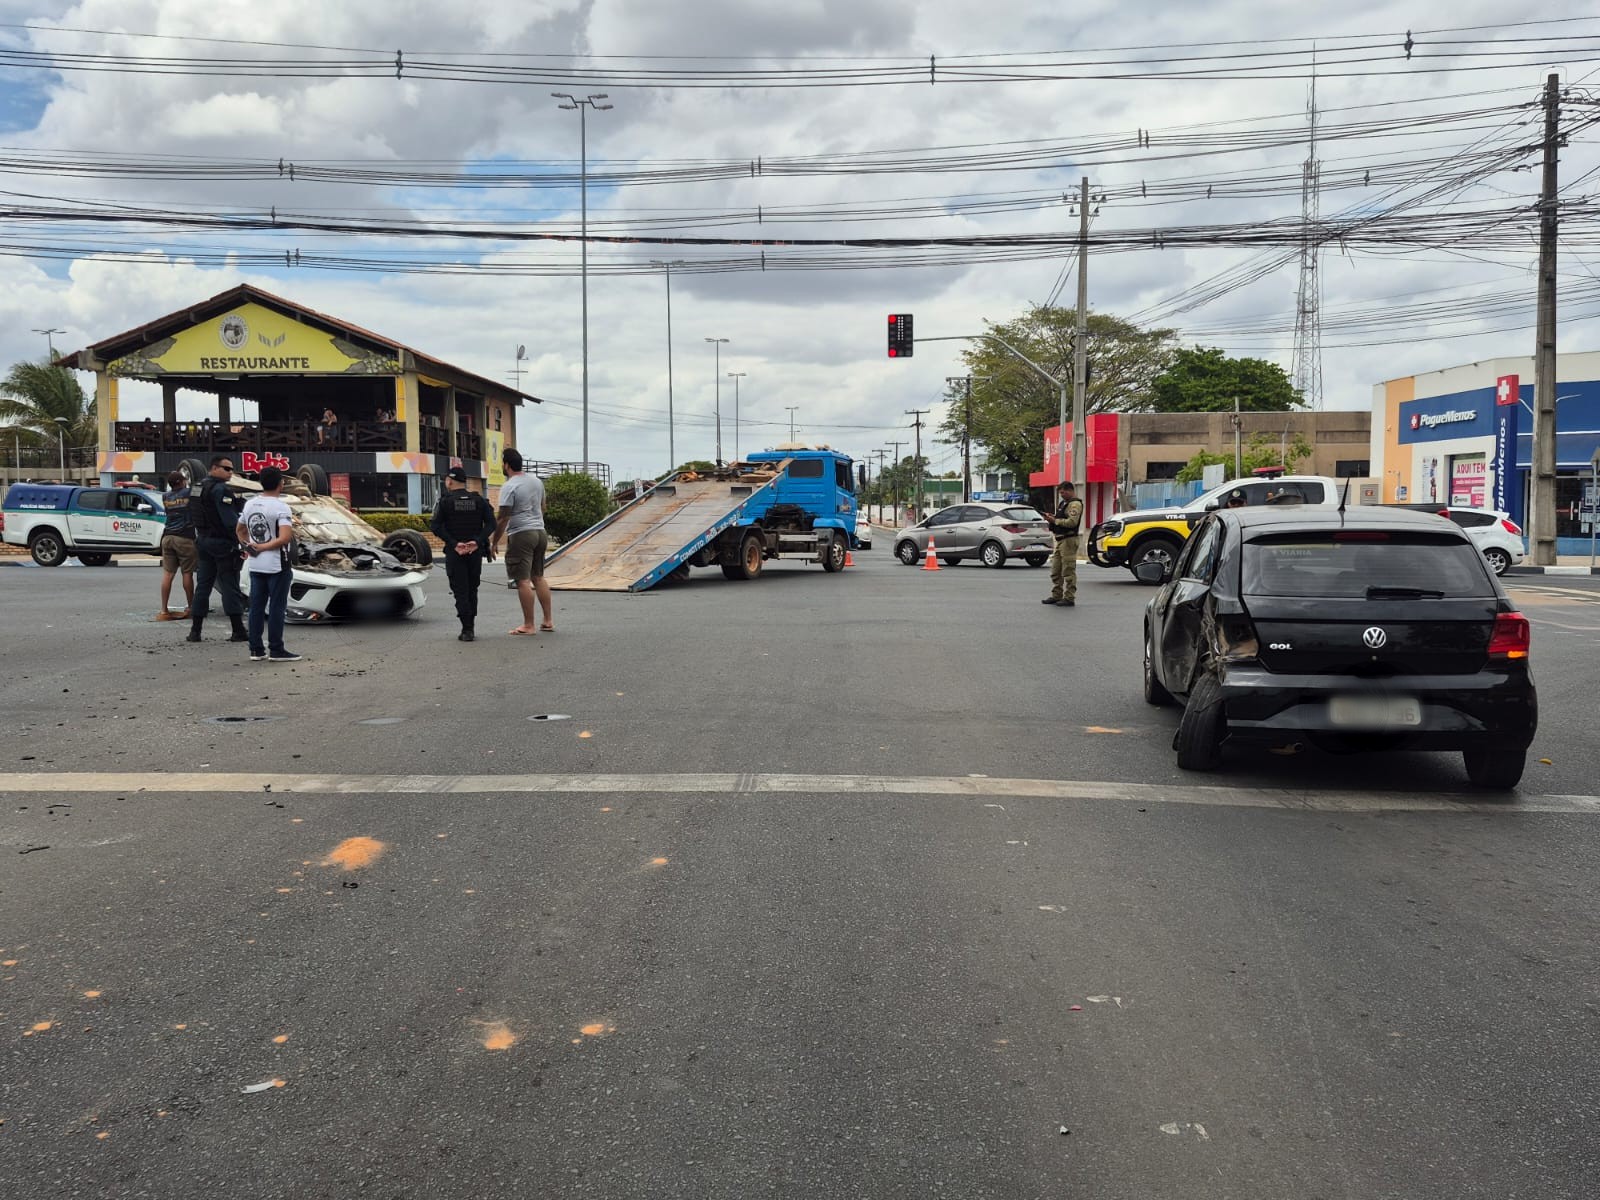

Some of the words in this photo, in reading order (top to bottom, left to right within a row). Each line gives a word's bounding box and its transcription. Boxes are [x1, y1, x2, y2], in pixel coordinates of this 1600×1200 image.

[200, 357, 310, 370] RESTAURANTE
[1420, 409, 1478, 428] PagueMenos
[242, 451, 290, 473] Bob's
[1456, 463, 1472, 474] AQUI
[1473, 462, 1486, 473] TEM
[1498, 417, 1506, 512] gueMenos
